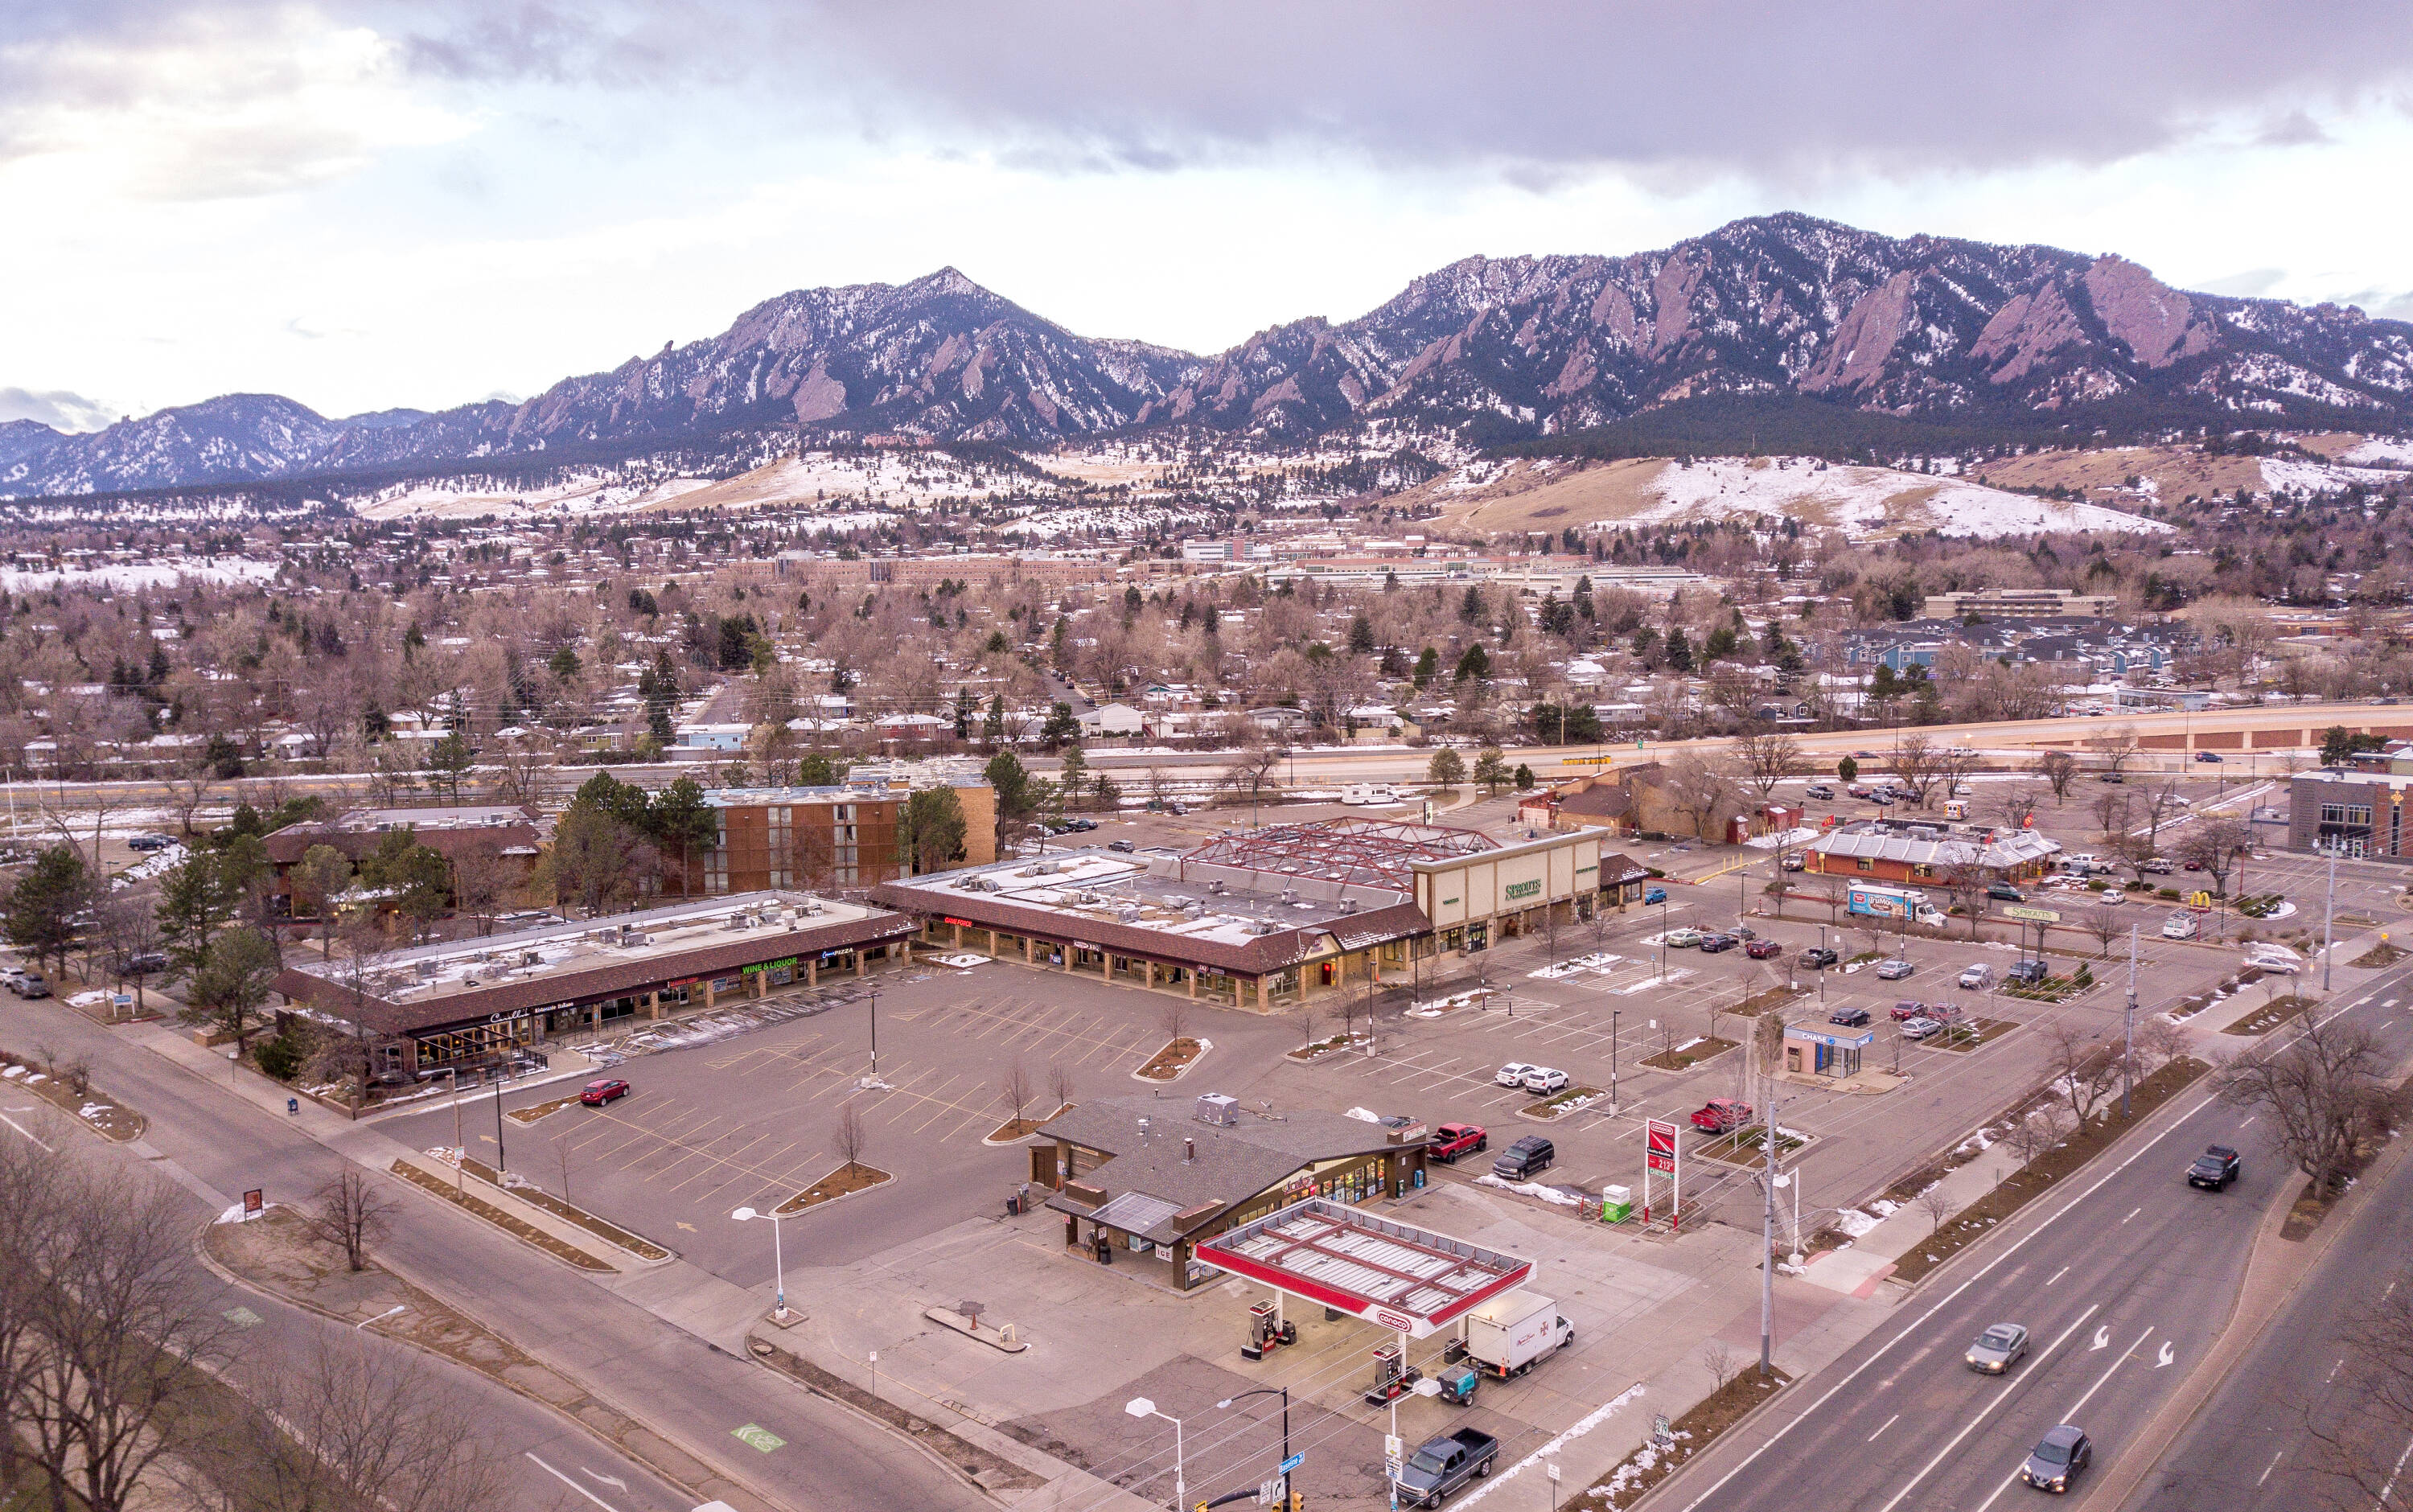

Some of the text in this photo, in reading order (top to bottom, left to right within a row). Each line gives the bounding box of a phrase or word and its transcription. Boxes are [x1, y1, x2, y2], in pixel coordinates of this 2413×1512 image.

[1505, 878, 1542, 901] SPROUTS
[2012, 907, 2052, 918] SPROUTS
[834, 947, 853, 956] PIZZA
[742, 957, 798, 974] WINE & LIQUOR
[1802, 1033, 1827, 1043] CHASE
[1857, 1037, 1870, 1047] CHASE
[1650, 1168, 1674, 1180] DIESEL
[1157, 1247, 1171, 1259] ICE
[1280, 1457, 1298, 1473] Baseline
[1273, 1493, 1284, 1502] ONLY
